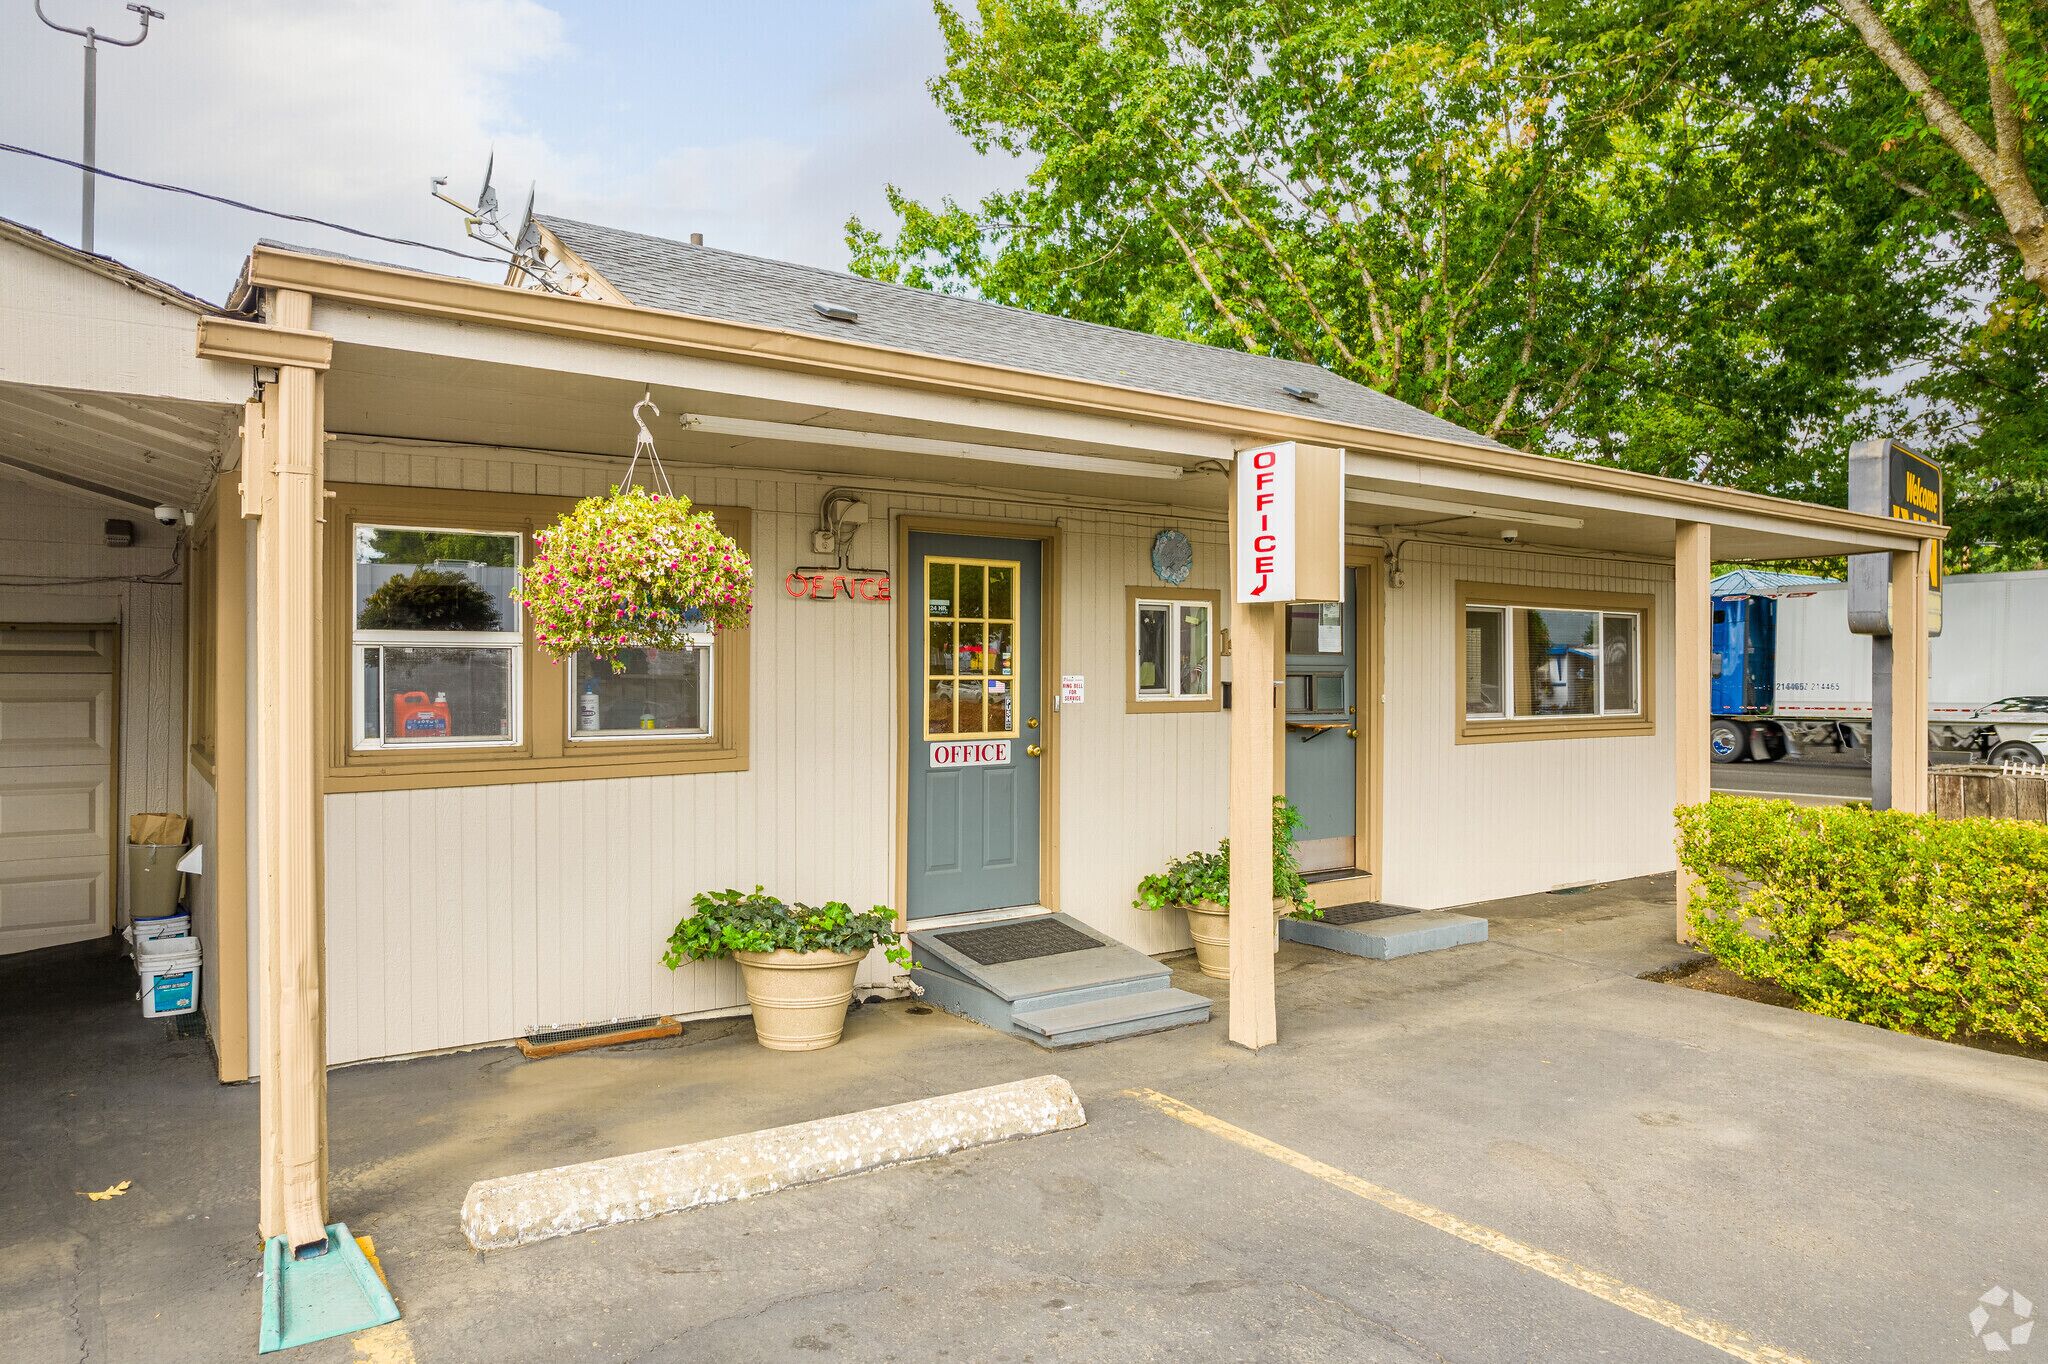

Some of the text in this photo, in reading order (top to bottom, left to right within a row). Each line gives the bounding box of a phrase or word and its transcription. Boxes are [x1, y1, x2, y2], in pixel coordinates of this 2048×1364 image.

[1906, 471, 1937, 514] Welcome
[1253, 451, 1277, 574] OFFICE
[785, 573, 892, 600] OFFICE
[934, 743, 1007, 764] OFFICE
